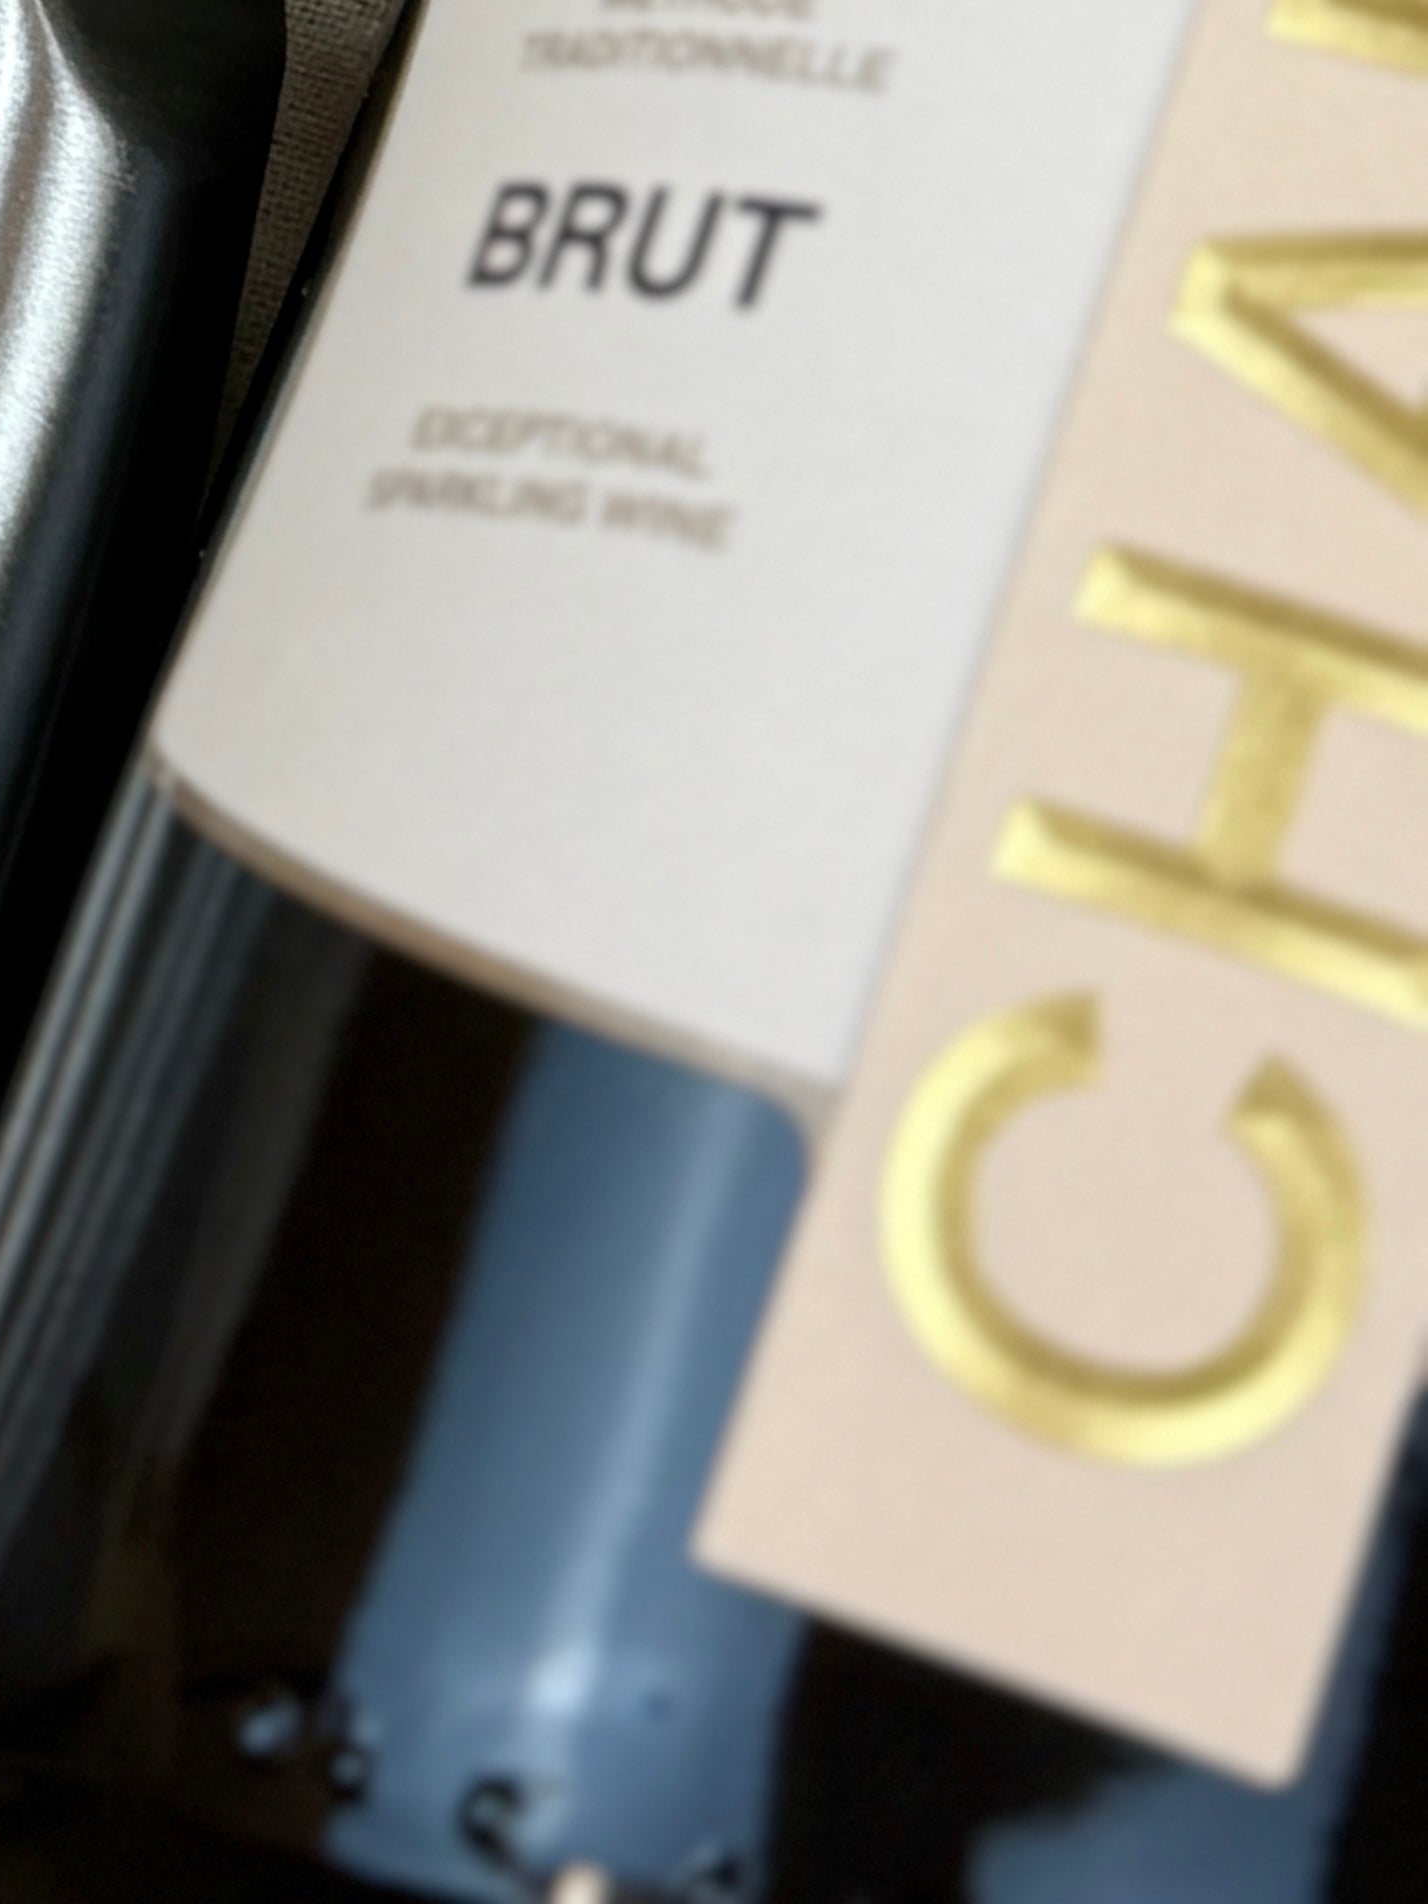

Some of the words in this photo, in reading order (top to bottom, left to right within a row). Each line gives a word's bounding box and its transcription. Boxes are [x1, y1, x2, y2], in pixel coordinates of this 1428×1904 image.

[522, 28, 894, 98] TRADITIONNELLE
[464, 180, 826, 312] BRUT
[408, 404, 710, 484] EXCEPTIONAL
